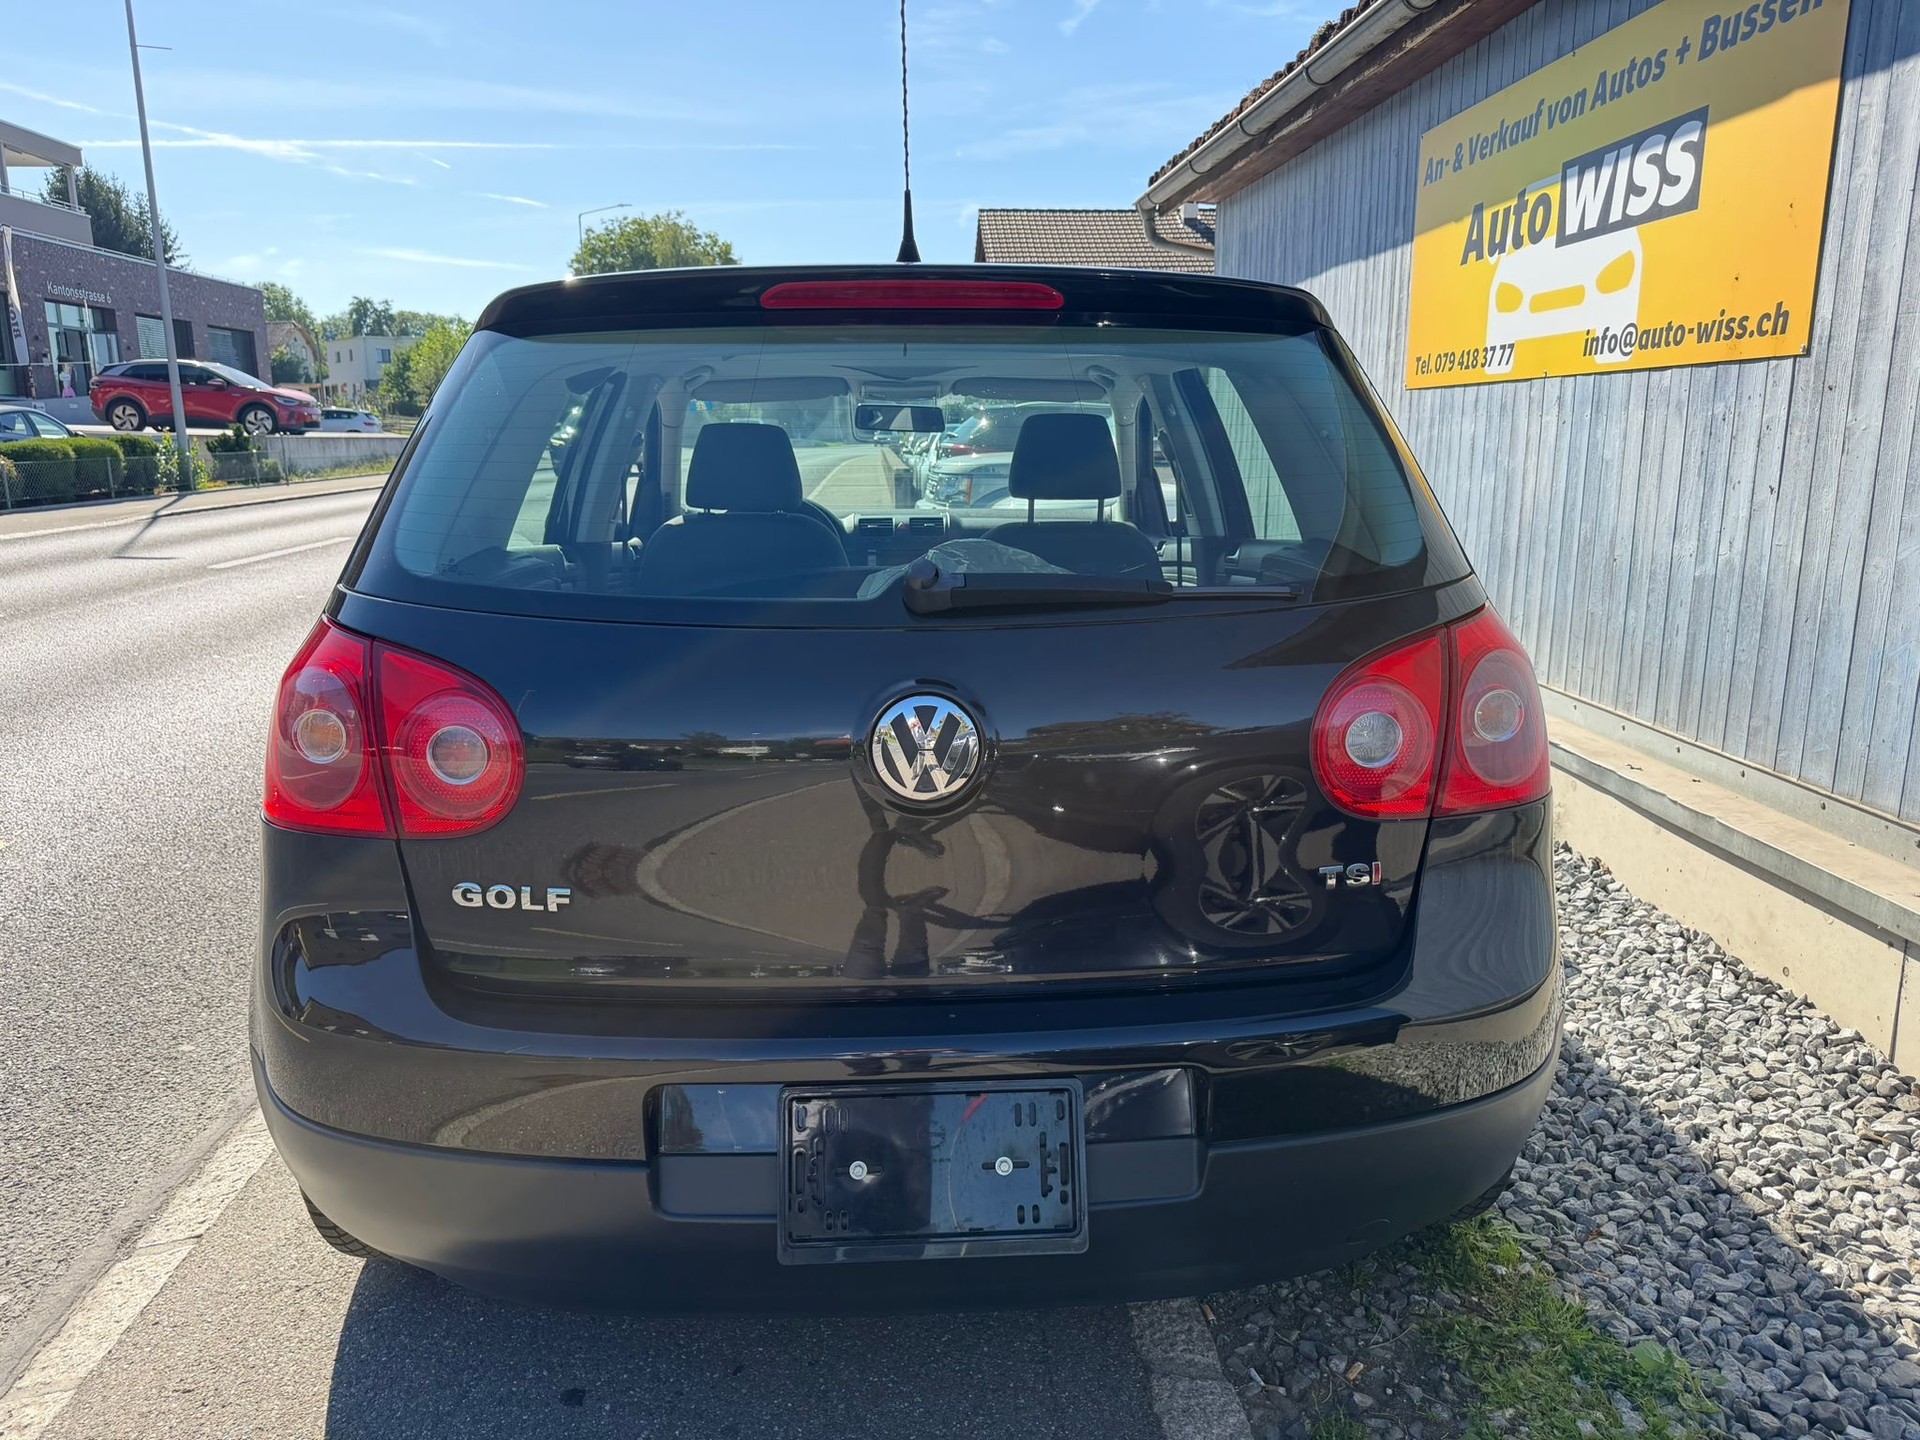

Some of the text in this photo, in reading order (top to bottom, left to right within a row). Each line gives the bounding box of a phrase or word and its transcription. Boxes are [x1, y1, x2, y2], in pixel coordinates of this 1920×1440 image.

[1423, 156, 1450, 187] An-
[1452, 142, 1463, 173] &
[1468, 98, 1545, 166] Verkauf
[1548, 87, 1587, 130] von
[1590, 49, 1668, 111] Autos
[1676, 35, 1691, 65] +
[1460, 120, 1702, 266] Auto WISS
[46, 280, 112, 304] Kantonsstrasse 6
[1582, 300, 1790, 358] info@auto-wiss.ch
[1415, 342, 1515, 376] Tel. 079 418 37 77
[451, 882, 571, 912] GOLF
